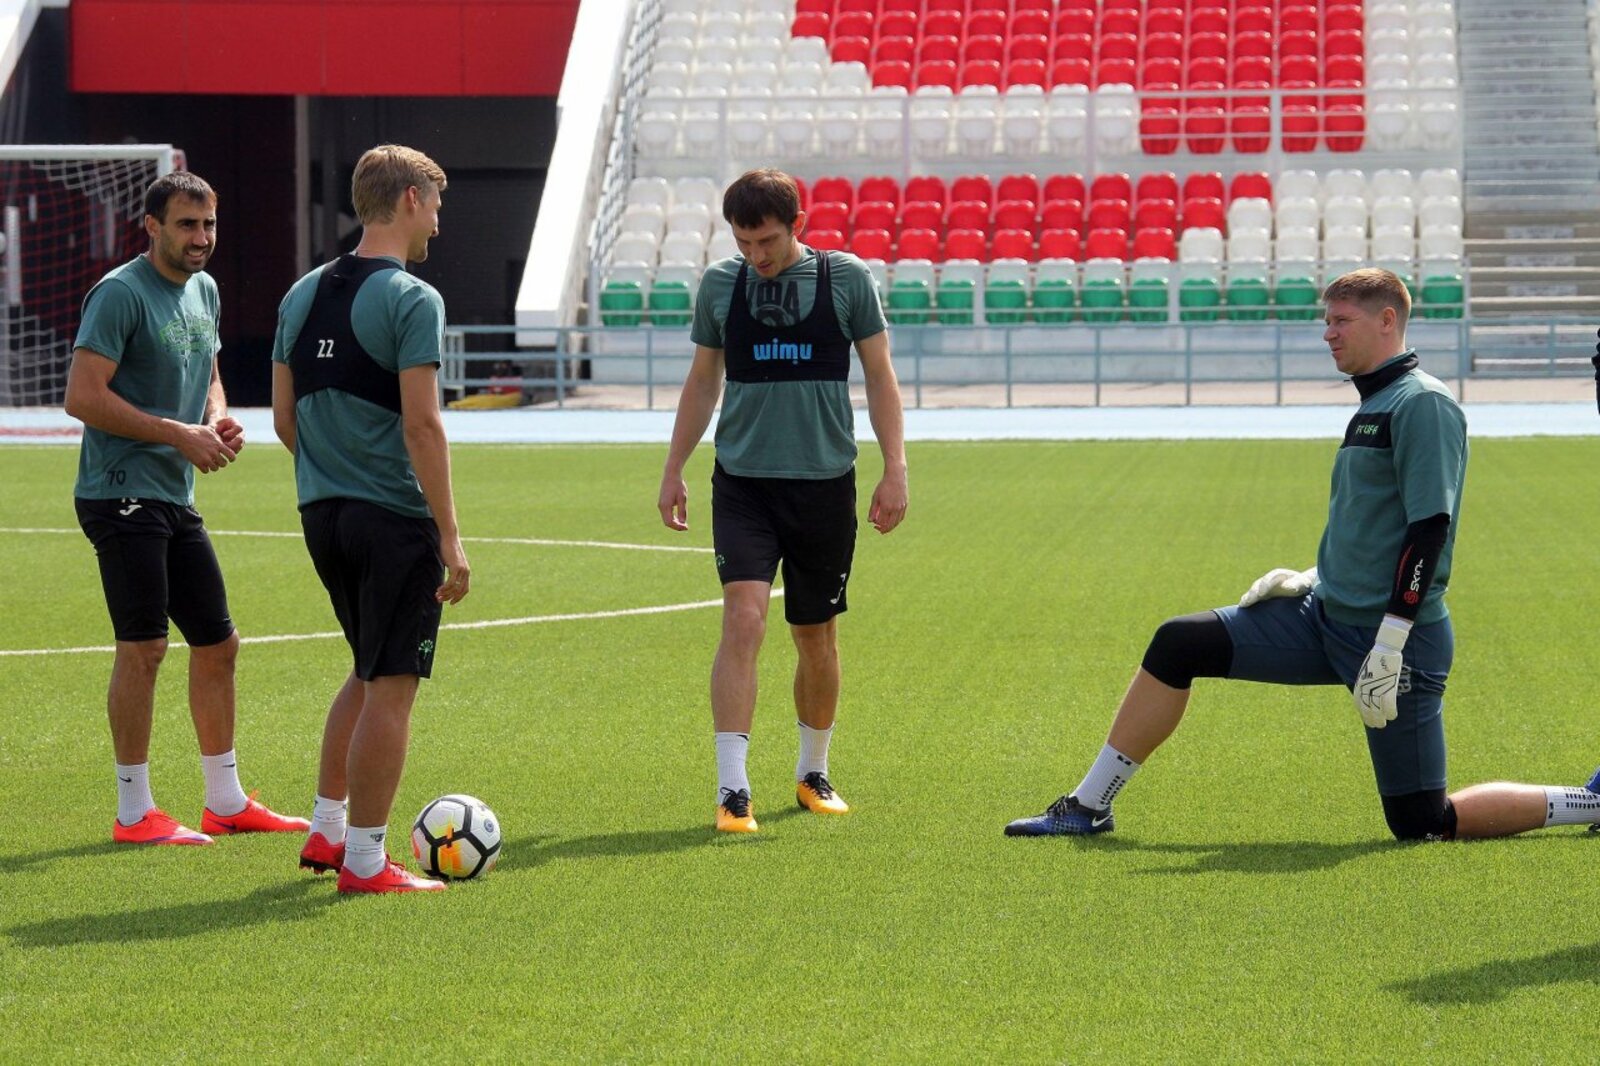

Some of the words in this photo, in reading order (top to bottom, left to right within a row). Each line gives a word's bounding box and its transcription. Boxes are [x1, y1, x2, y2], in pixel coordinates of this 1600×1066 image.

[317, 339, 335, 358] 22
[753, 337, 813, 365] wimu
[107, 470, 126, 486] 70
